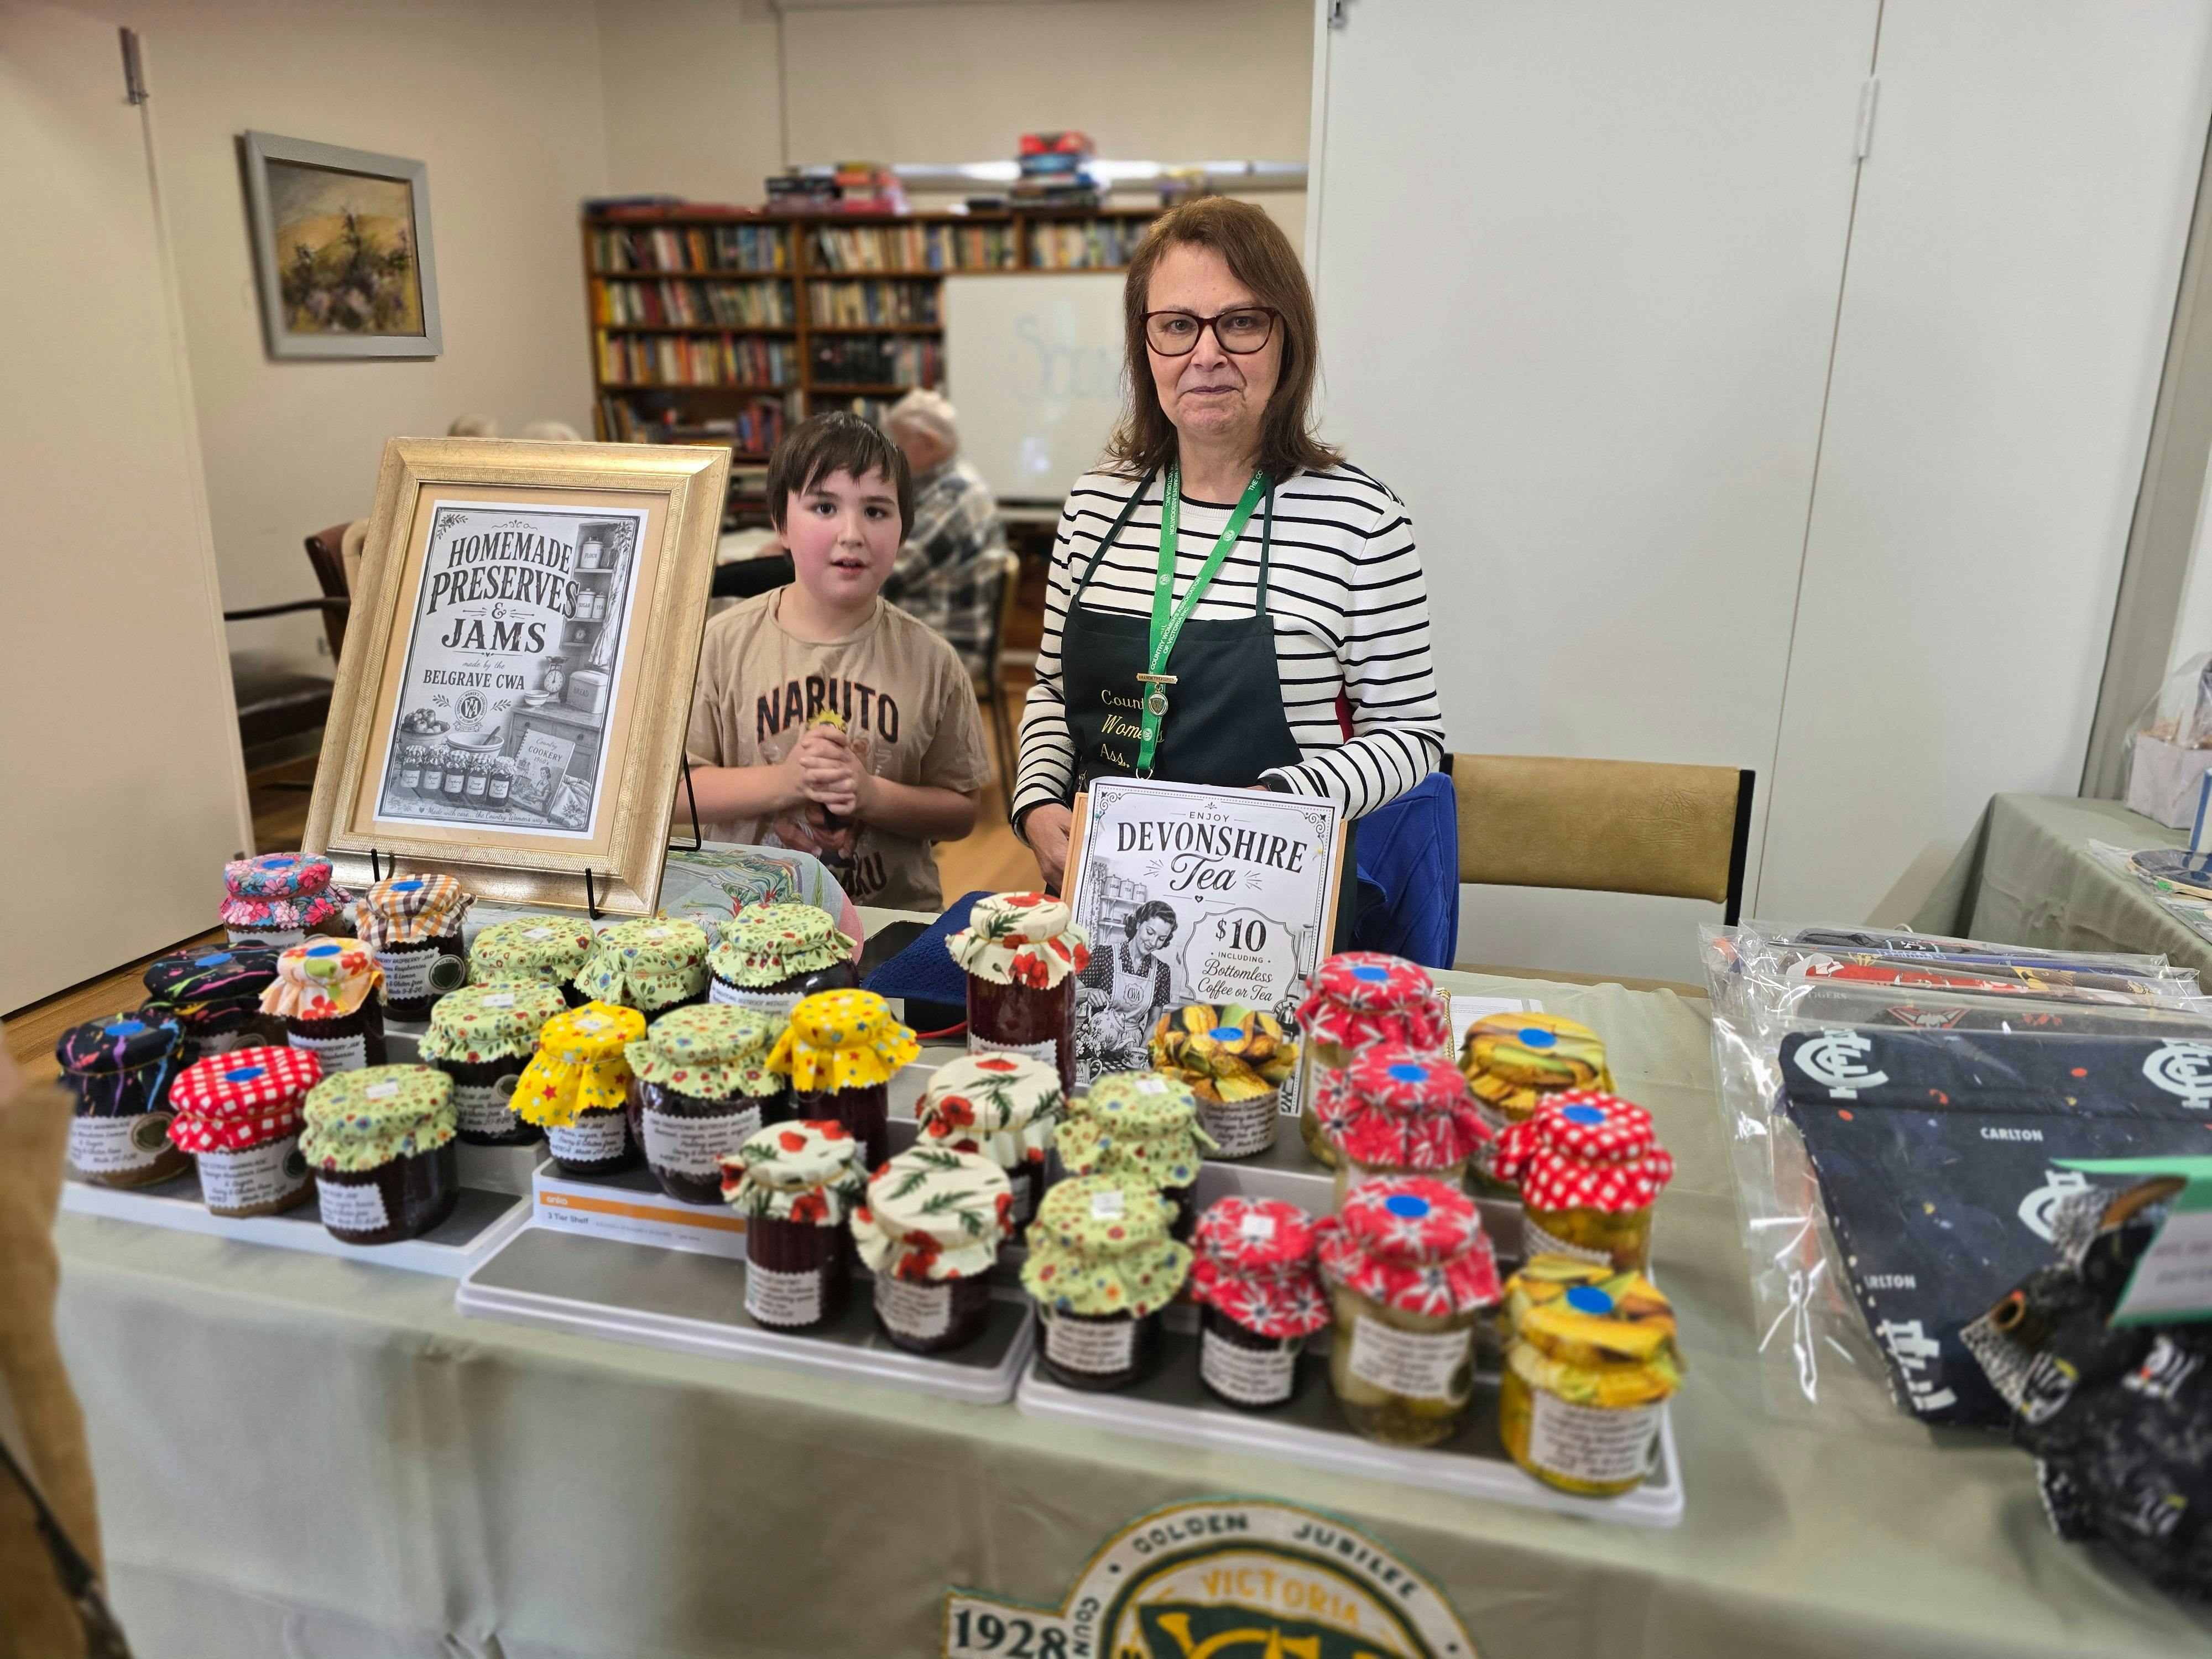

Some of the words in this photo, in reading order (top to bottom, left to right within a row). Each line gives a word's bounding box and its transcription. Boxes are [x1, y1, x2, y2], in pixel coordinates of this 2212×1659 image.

[1248, 479, 1259, 491] THE
[447, 531, 573, 575] HOMEMADE
[426, 565, 580, 619] PRESERVES
[491, 602, 507, 619] &
[1180, 606, 1190, 618] INC.
[1150, 639, 1165, 670] COUNTRY
[1161, 612, 1180, 640] WOMEN'S
[1177, 576, 1202, 614] ASSOCIATION
[1166, 617, 1182, 645] VICTORIA
[441, 618, 546, 653] JAMS
[1163, 644, 1170, 654] OF
[462, 659, 481, 667] made
[483, 660, 491, 671] by
[494, 660, 505, 670] the
[423, 669, 492, 688] BELGRAVE
[496, 674, 525, 690] CWA
[573, 686, 589, 698] BREAD
[757, 676, 899, 744] NARUTO
[528, 745, 563, 762] COOKERY
[475, 810, 484, 818] the
[486, 811, 507, 822] Country
[508, 813, 531, 822] Women's
[1189, 811, 1230, 823] ENJOY
[1117, 822, 1308, 874] DEVONSHIRE
[1169, 853, 1237, 891] Tea
[1215, 917, 1266, 952] $10
[1218, 951, 1264, 963] INCLUDING
[1202, 958, 1273, 983] Bottomless
[1198, 977, 1233, 999] Coffee
[1235, 988, 1249, 998] or
[1250, 984, 1273, 1001] Tea
[1980, 1126, 2044, 1142] CARLTON
[554, 1212, 568, 1222] Tier
[570, 1214, 589, 1224] Shelf
[1133, 1514, 1250, 1554] GOLDEN
[1293, 1522, 1419, 1600] JUBILEE
[1201, 1567, 1360, 1629] VICTORIA
[953, 1608, 1068, 1659] 1928
